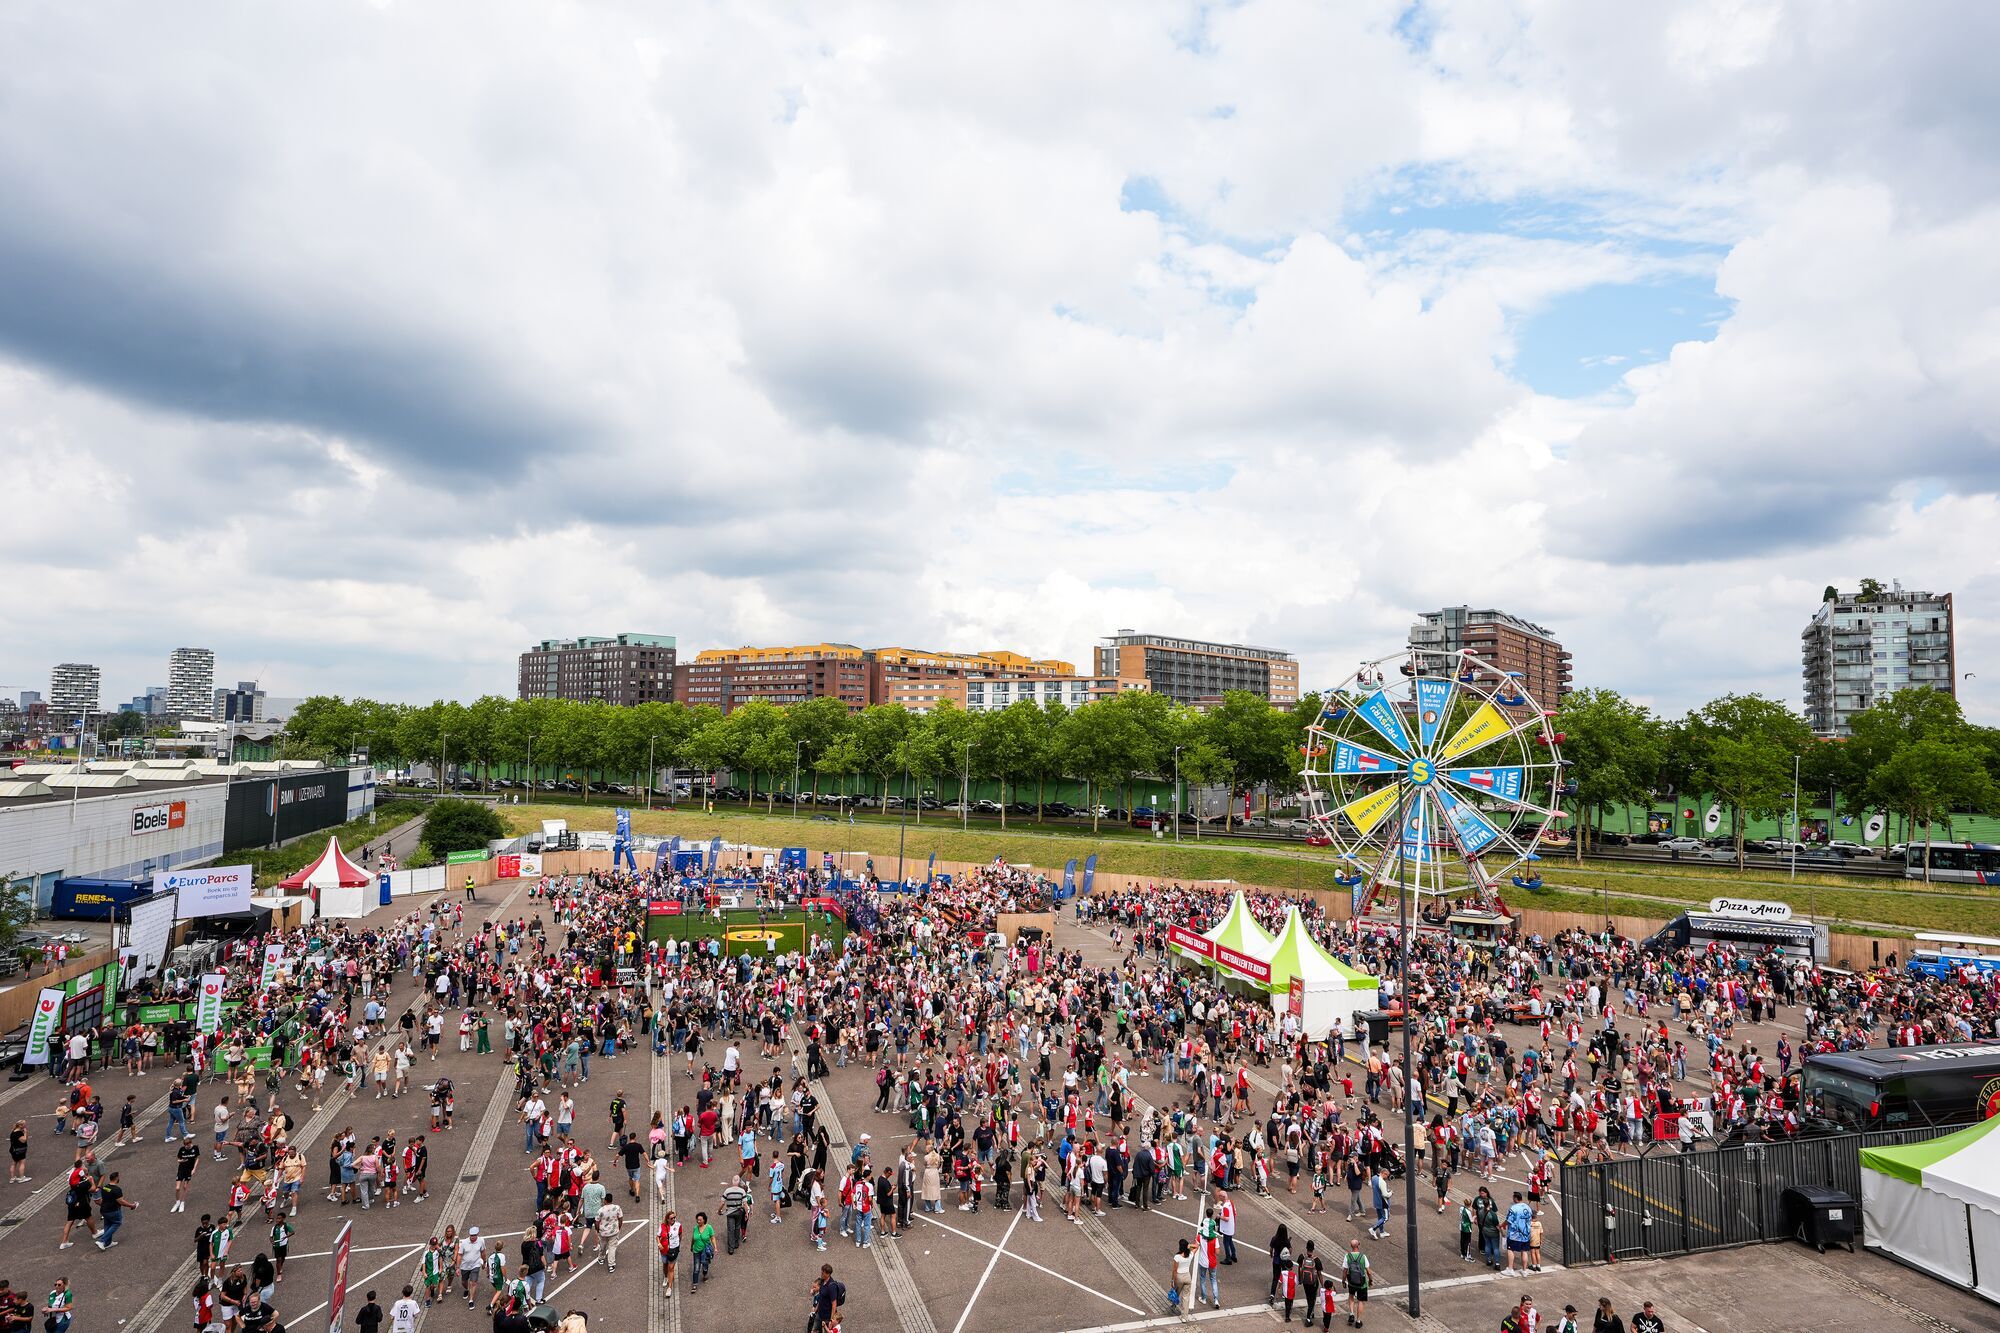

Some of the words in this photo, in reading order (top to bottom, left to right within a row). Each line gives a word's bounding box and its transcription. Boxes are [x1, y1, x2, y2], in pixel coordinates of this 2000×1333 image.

[1422, 683, 1446, 695] WIN
[1453, 736, 1469, 750] SPIN
[1473, 720, 1491, 735] WIN!
[1337, 747, 1349, 770] WIN
[1505, 771, 1519, 796] WIN
[134, 810, 168, 831] Boels
[1466, 830, 1492, 849] WIN
[179, 874, 239, 887] EuroParcs
[31, 999, 55, 1055] univé
[400, 1309, 408, 1318] 10
